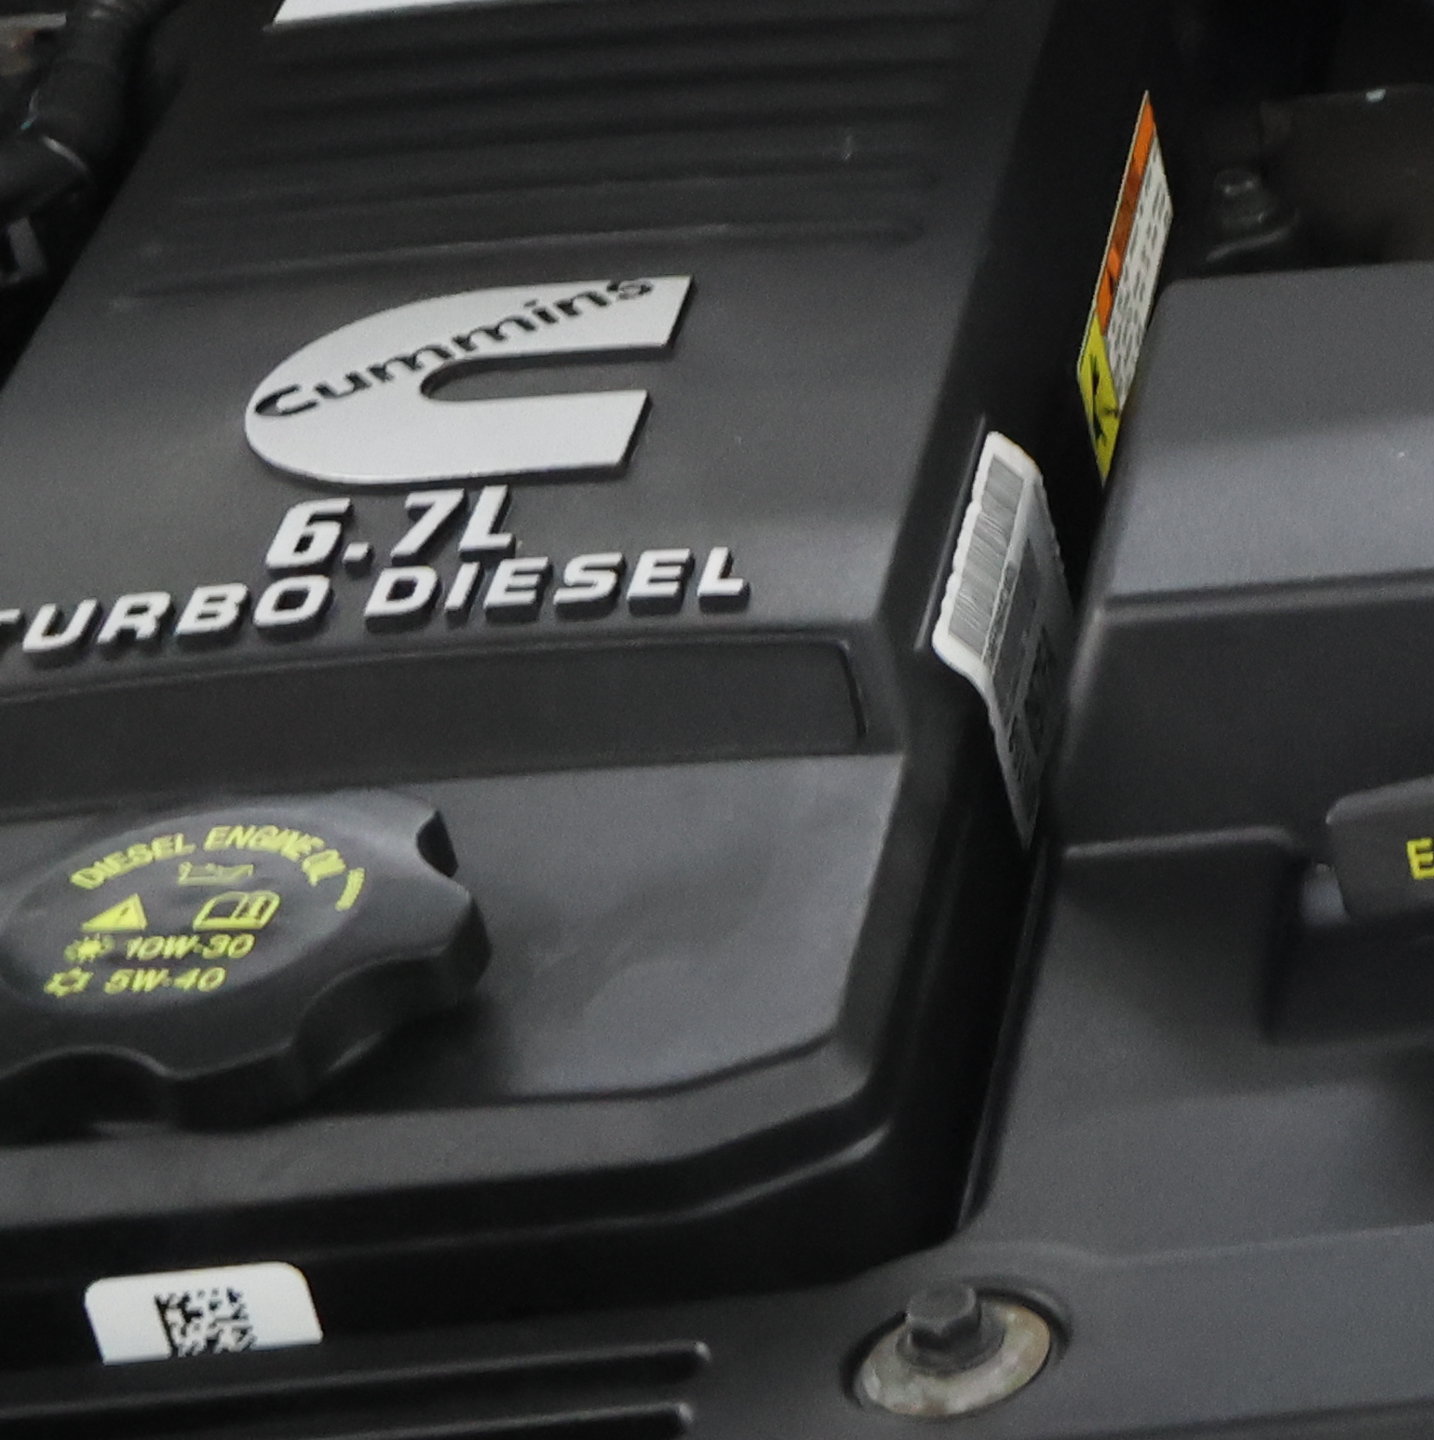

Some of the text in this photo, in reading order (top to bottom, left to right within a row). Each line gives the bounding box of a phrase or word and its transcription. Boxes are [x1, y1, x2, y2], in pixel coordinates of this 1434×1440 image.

[254, 275, 657, 418] Cummins
[265, 484, 518, 570] 6.7L
[0, 546, 749, 652] URBO DIESEL
[69, 832, 197, 890] DIESEL
[203, 823, 325, 863] ENGINE
[104, 966, 227, 995] 5W-40
[125, 933, 256, 960] 10W-30
